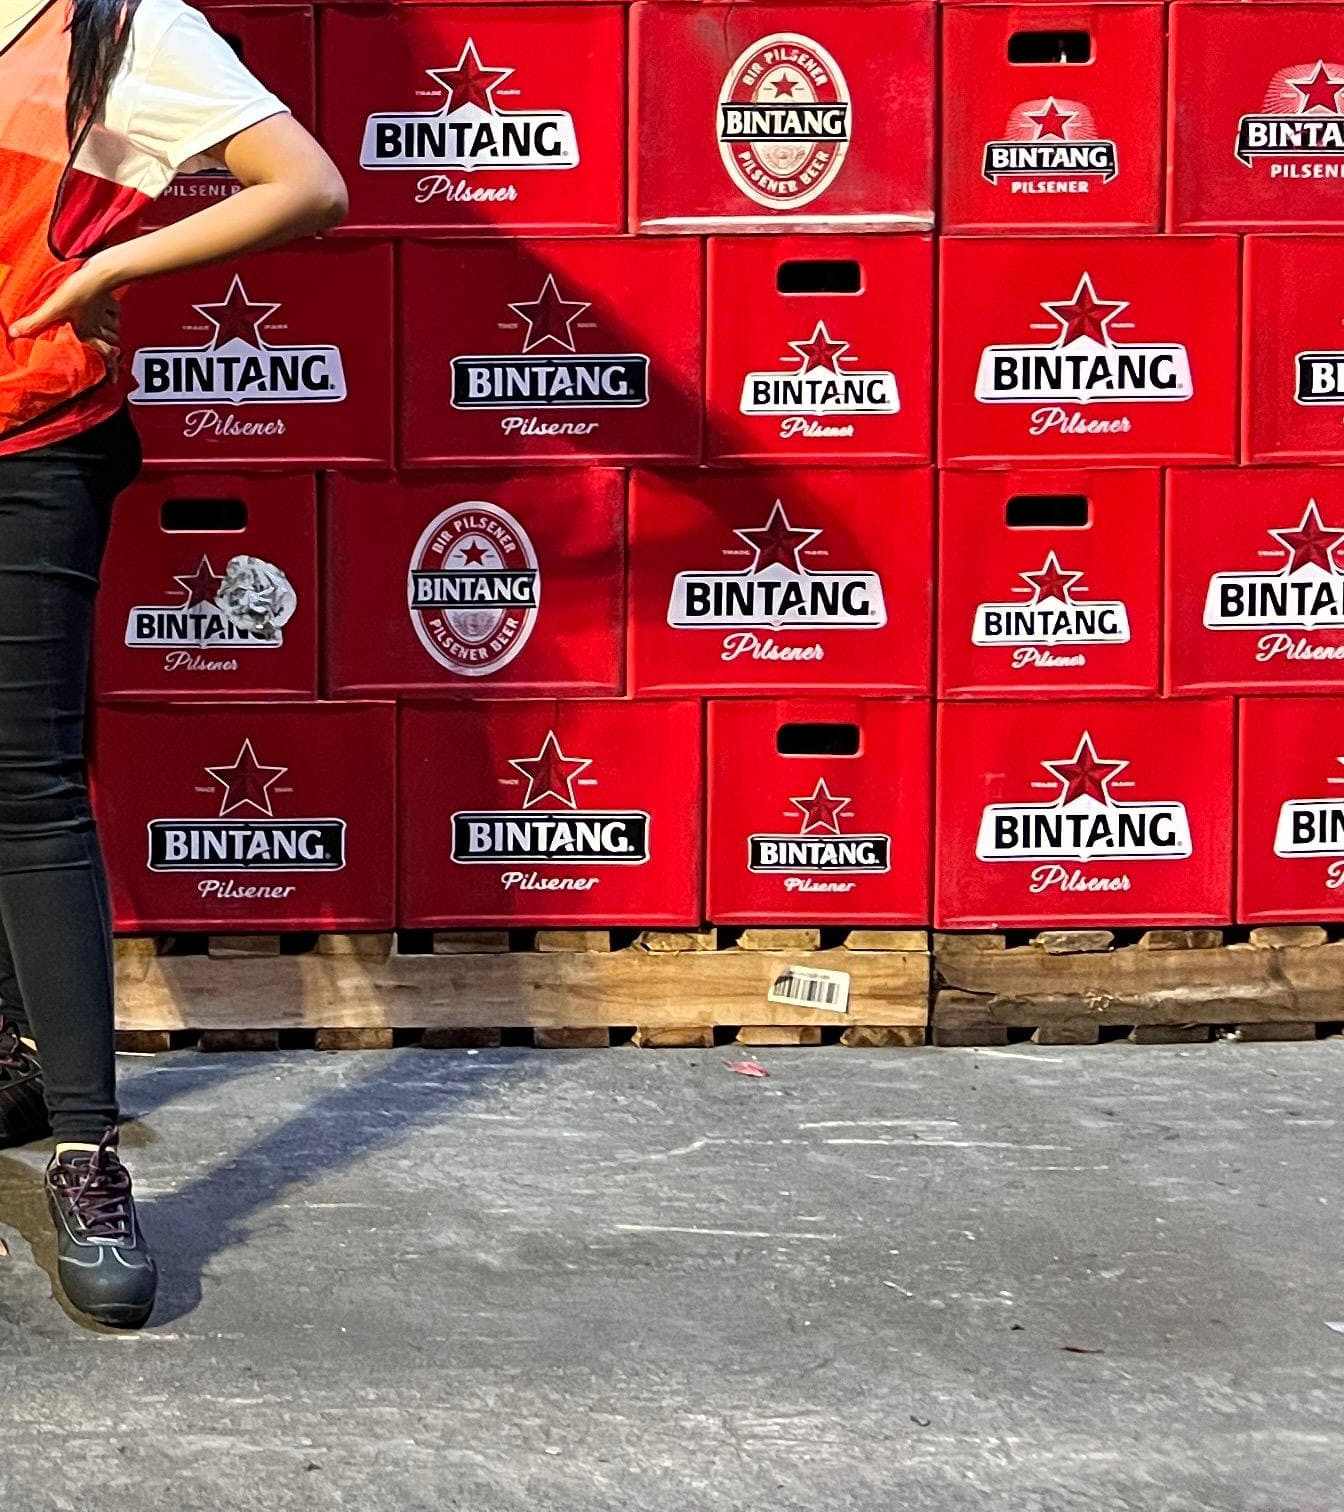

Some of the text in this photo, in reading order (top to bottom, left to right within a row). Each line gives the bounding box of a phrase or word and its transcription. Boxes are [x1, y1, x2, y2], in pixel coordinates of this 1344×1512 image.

[742, 48, 828, 86] BIR PILSENER
[378, 122, 561, 157] BINTANG
[726, 110, 842, 135] BINTANG
[738, 151, 829, 194] PILSENER BEER
[1012, 181, 1089, 194] PILSENER
[146, 357, 329, 392] BINTANG
[994, 355, 1177, 390] BINTANG
[184, 408, 286, 438] Pilsener
[780, 416, 856, 438] Pilsener
[431, 516, 517, 554] BIR PILSENER
[417, 576, 531, 601] BINTANG
[686, 581, 869, 616] BINTANG
[429, 617, 519, 660] PILSENER BEER
[994, 813, 1177, 848] BINTANG
[502, 871, 600, 892] Pilsener
[1032, 864, 1134, 894] Pilsener
